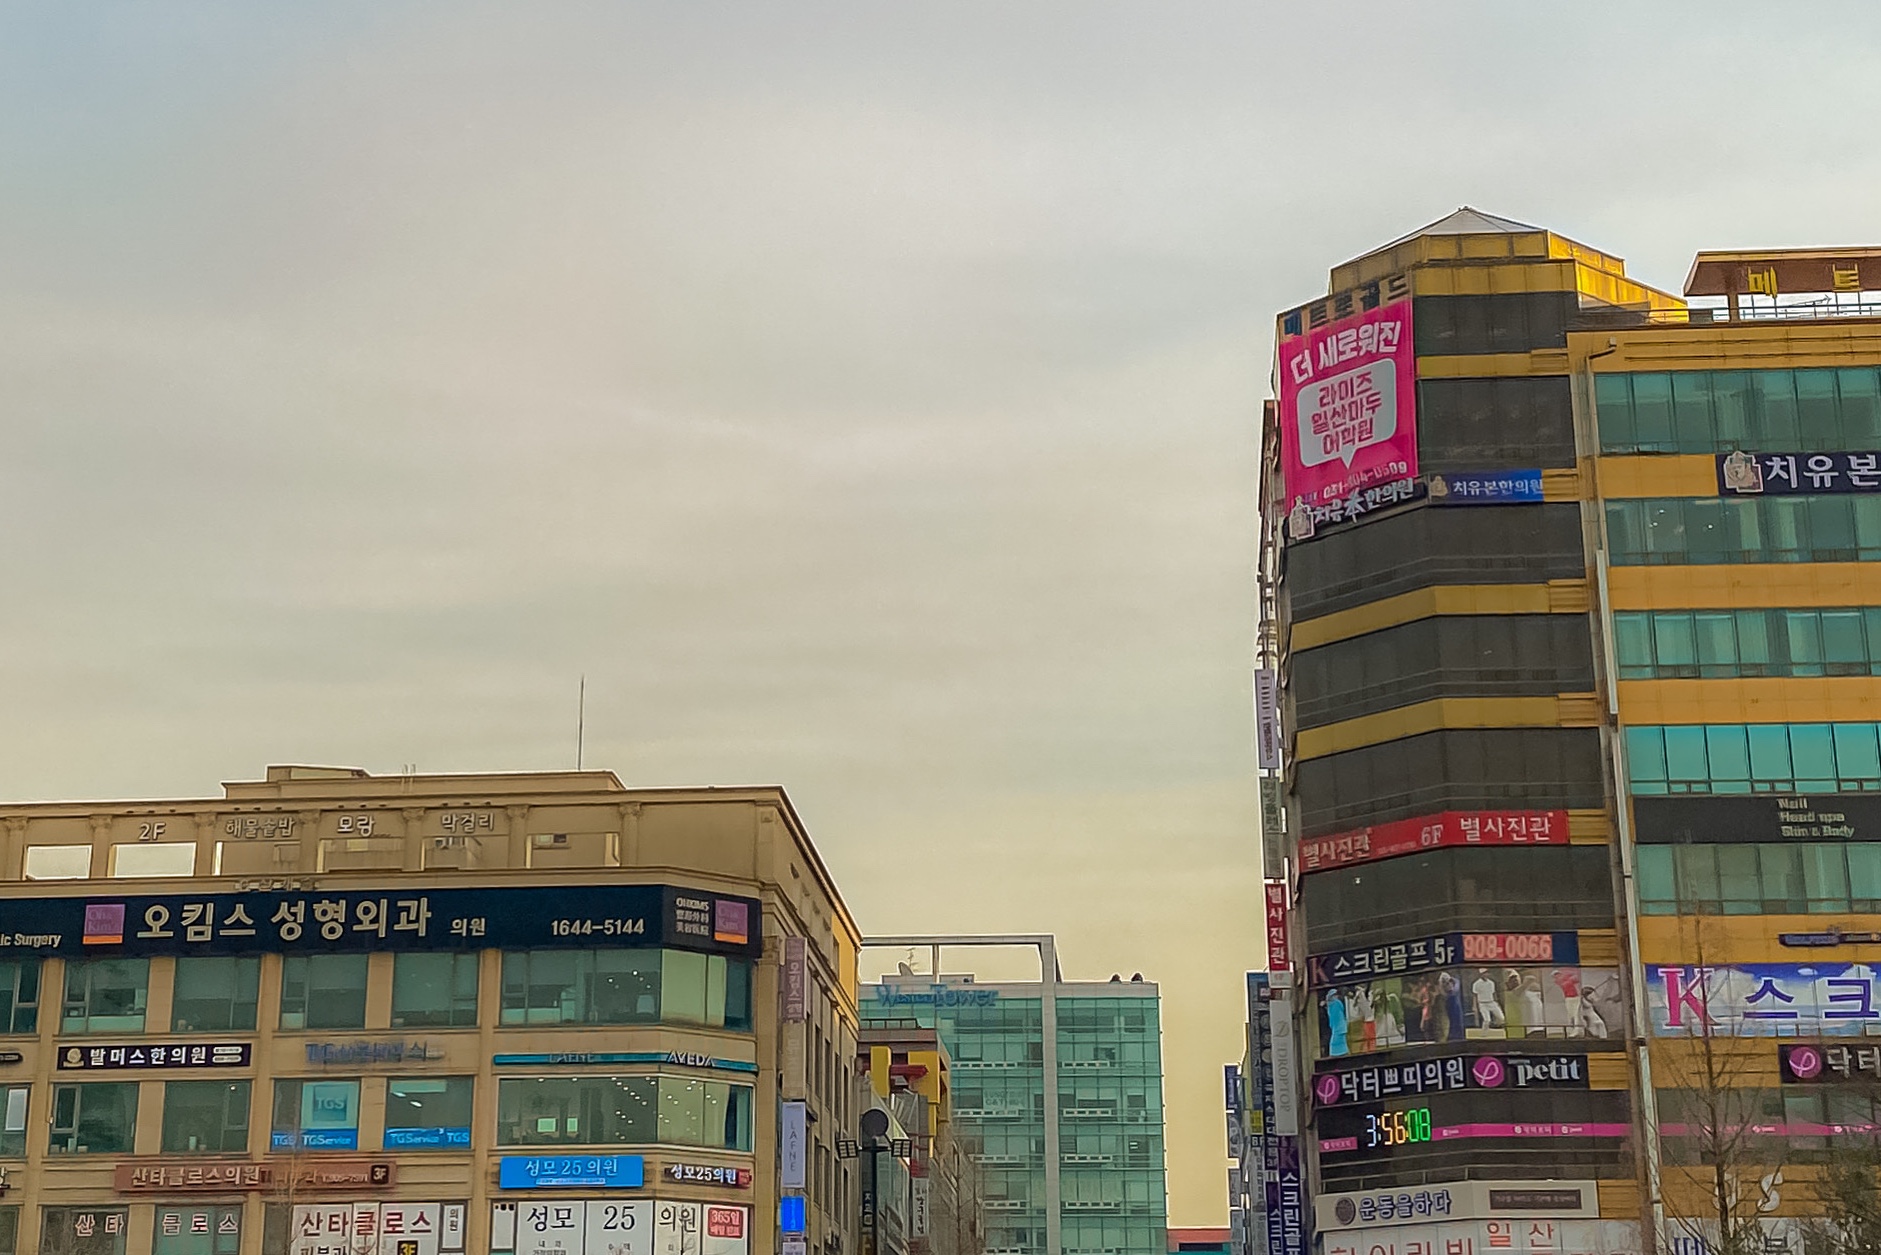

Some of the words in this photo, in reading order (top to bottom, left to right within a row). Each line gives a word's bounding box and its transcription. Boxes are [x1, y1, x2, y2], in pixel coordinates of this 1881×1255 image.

[1290, 348, 1314, 385] 더
[1318, 371, 1373, 408] 라이즈
[1311, 392, 1382, 435] 일산마두
[1322, 418, 1374, 455] 어학원
[1452, 476, 1543, 497] 치유본한의원
[138, 822, 167, 841] 2F
[226, 816, 298, 839] 해물솥밥
[336, 815, 376, 838] 모랑
[440, 811, 495, 833] 막걸리
[1420, 823, 1444, 847] 6F
[1459, 813, 1553, 842] 별사진관
[1302, 829, 1372, 868] 별사진관
[137, 902, 256, 942] 오킴스
[270, 897, 432, 942] 성형외과
[449, 917, 486, 937] 의원
[551, 917, 645, 937] 1644-5144
[1267, 886, 1286, 966] 별사진관
[14, 933, 62, 949] Surgery
[1462, 934, 1553, 961] 908-0066
[1310, 955, 1330, 985] K
[1333, 942, 1431, 979] 스크린골프
[1434, 938, 1455, 966] 5F
[1657, 966, 1720, 1029] K
[1741, 977, 1881, 1021] 스크
[89, 1046, 208, 1067] 발머스한의원
[667, 1050, 716, 1067] AVEDA
[1341, 1057, 1466, 1102] 닥터쁘띠의원
[1516, 1058, 1581, 1086] petit
[315, 1097, 346, 1110] TGS
[373, 1167, 387, 1181] 3F
[525, 1158, 559, 1178] 성모
[560, 1158, 582, 1176] 25
[586, 1156, 618, 1176] 의원
[670, 1163, 737, 1185] 성모25의원
[711, 1210, 740, 1226] 365일
[1358, 1189, 1452, 1221] 운동을하다
[301, 1210, 433, 1237] 산타클로스
[525, 1206, 576, 1232] 성모
[602, 1206, 636, 1231] 25
[658, 1207, 698, 1234] 의원
[1487, 1221, 1555, 1248] 일산
